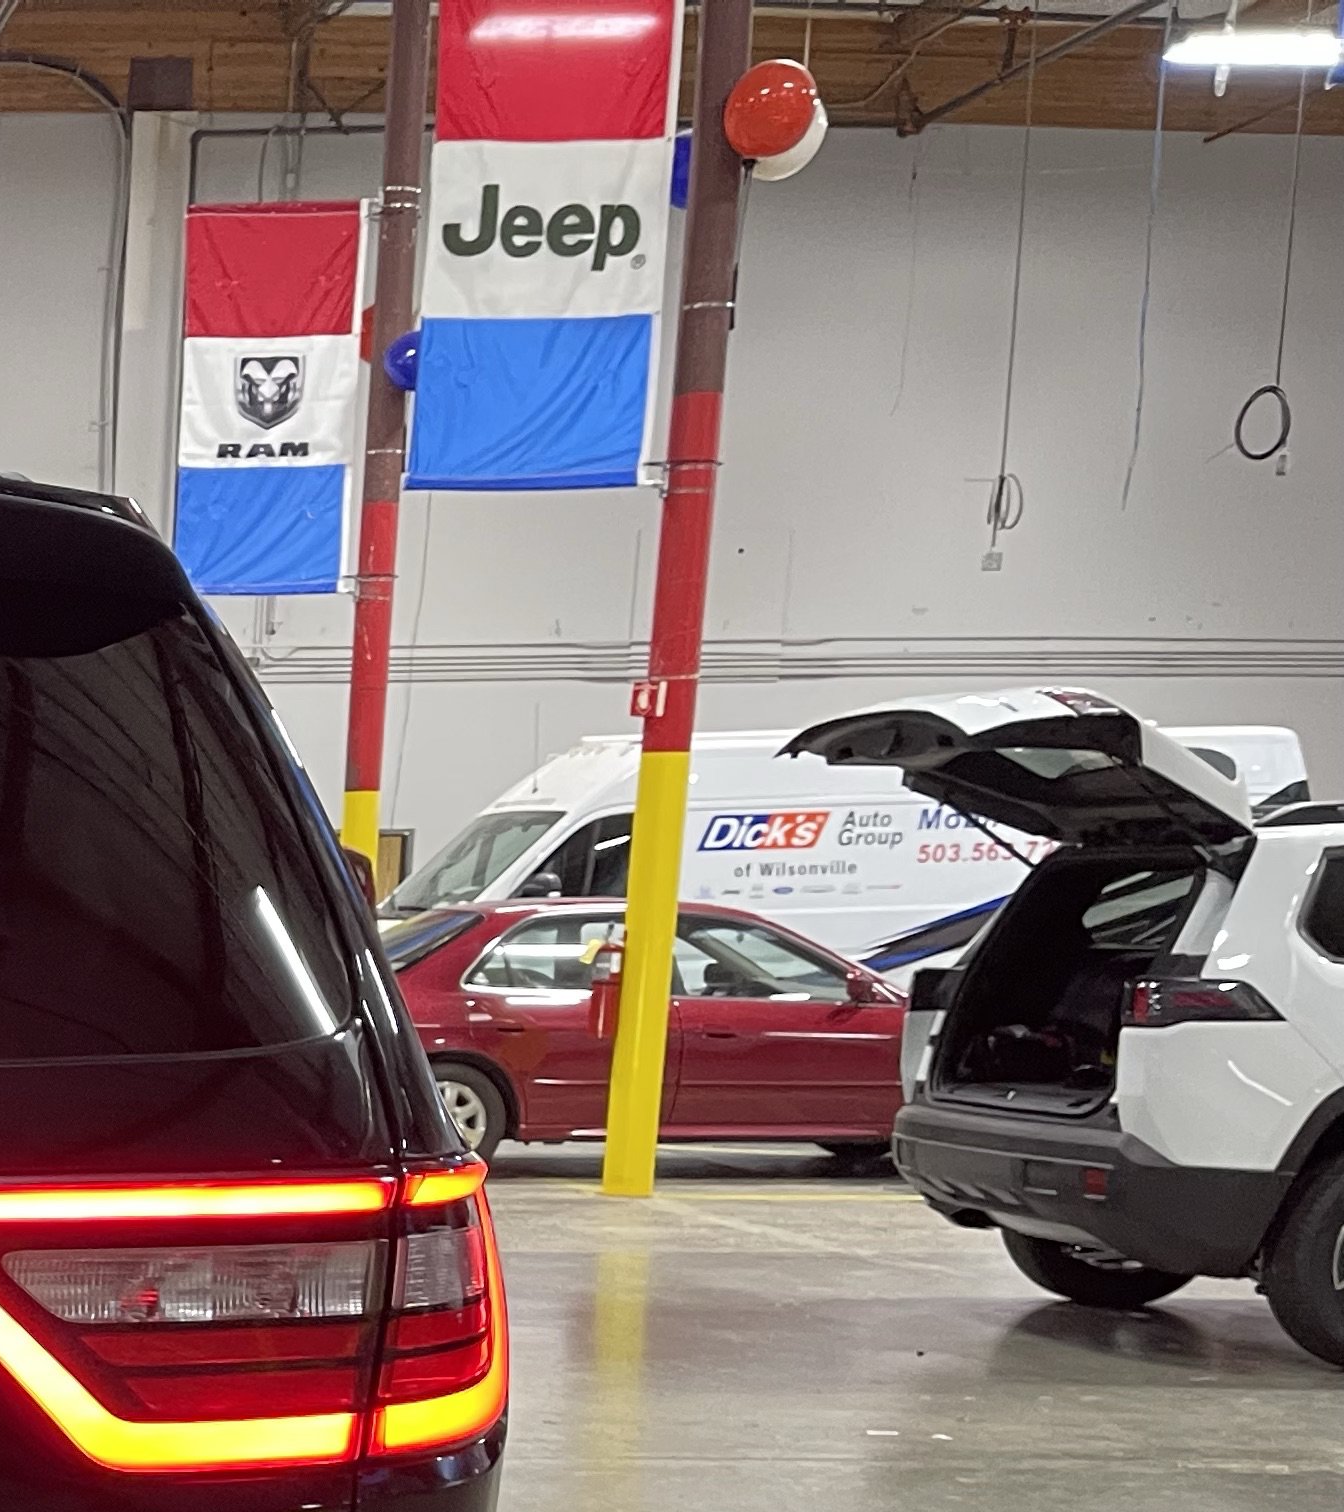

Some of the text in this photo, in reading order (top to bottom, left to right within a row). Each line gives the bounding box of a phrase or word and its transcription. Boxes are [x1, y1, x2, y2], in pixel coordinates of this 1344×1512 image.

[441, 184, 641, 271] Jeep
[216, 442, 310, 458] RAM
[842, 811, 892, 828] Auto
[703, 816, 819, 850] Dick's
[838, 829, 904, 850] Group
[734, 860, 858, 878] of Wilsonville
